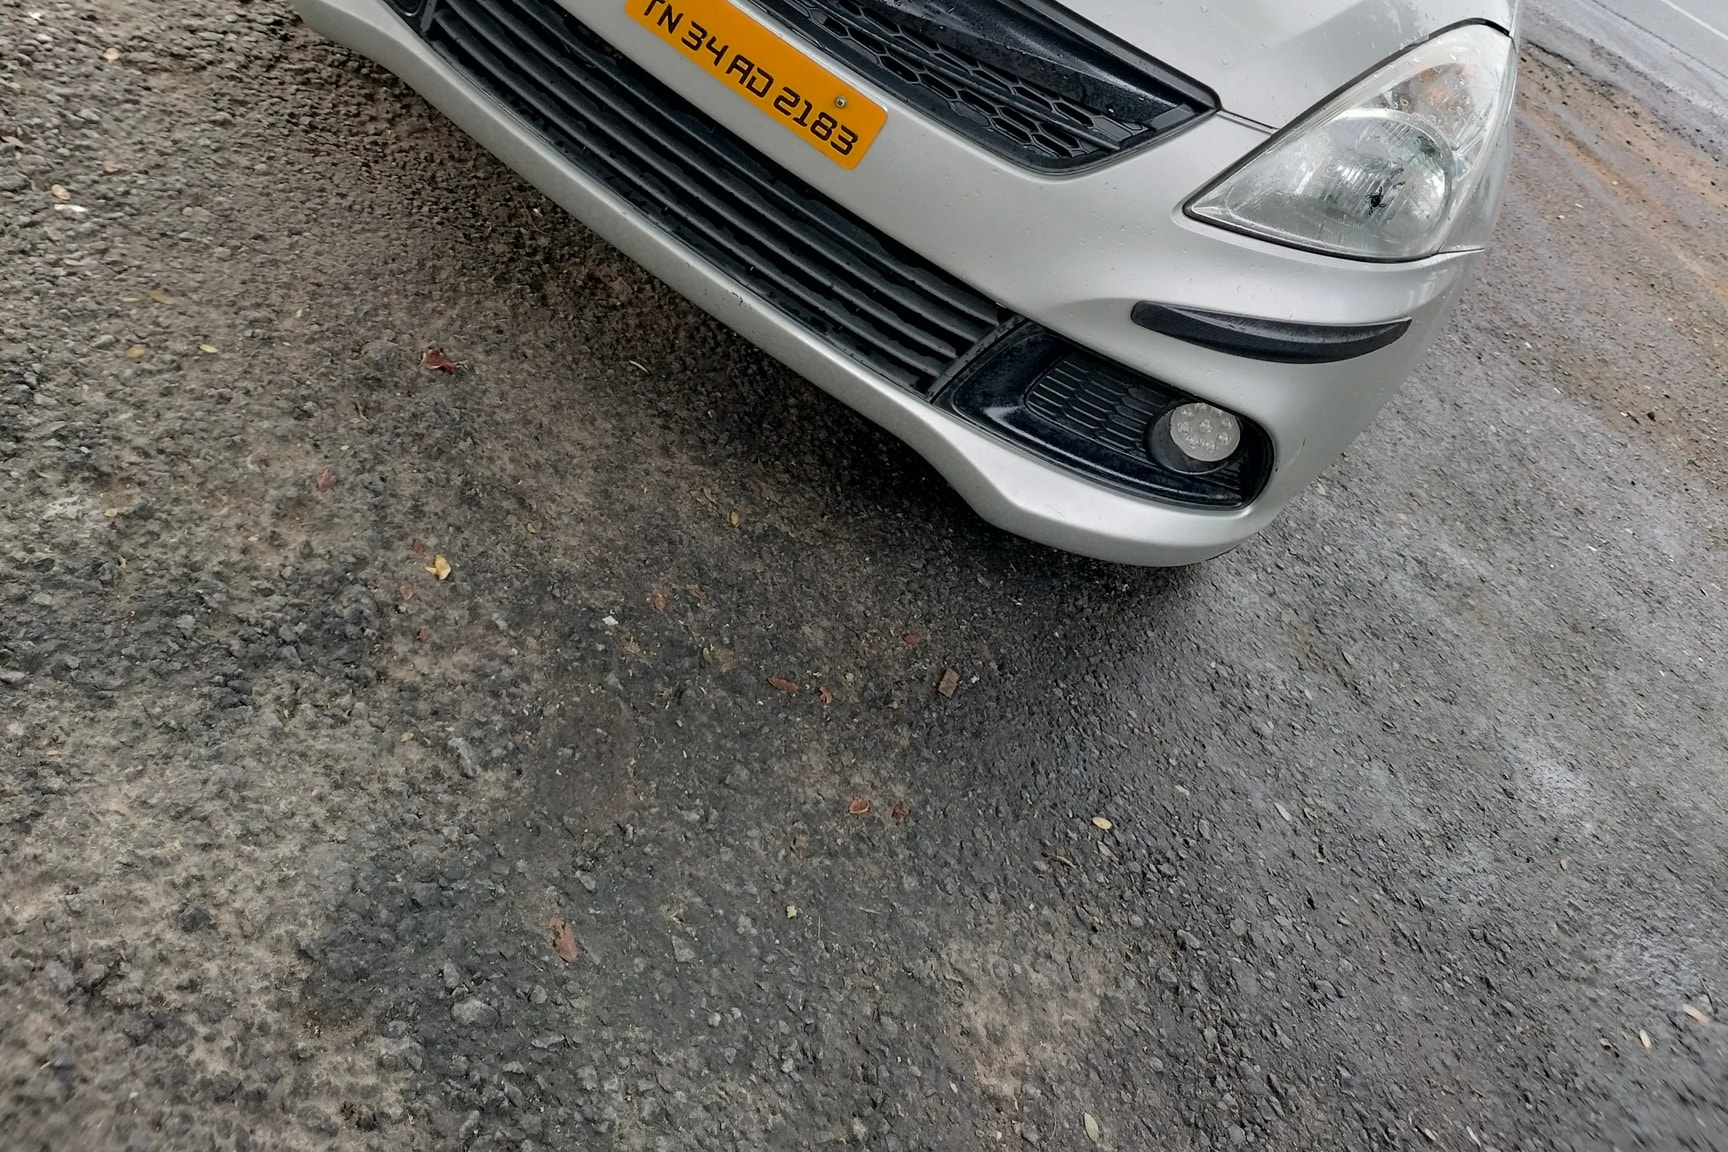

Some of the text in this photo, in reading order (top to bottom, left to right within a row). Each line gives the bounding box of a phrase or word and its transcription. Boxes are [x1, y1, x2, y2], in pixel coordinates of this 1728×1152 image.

[681, 20, 729, 67] 34
[725, 54, 774, 98] AD
[773, 86, 859, 156] 2183
